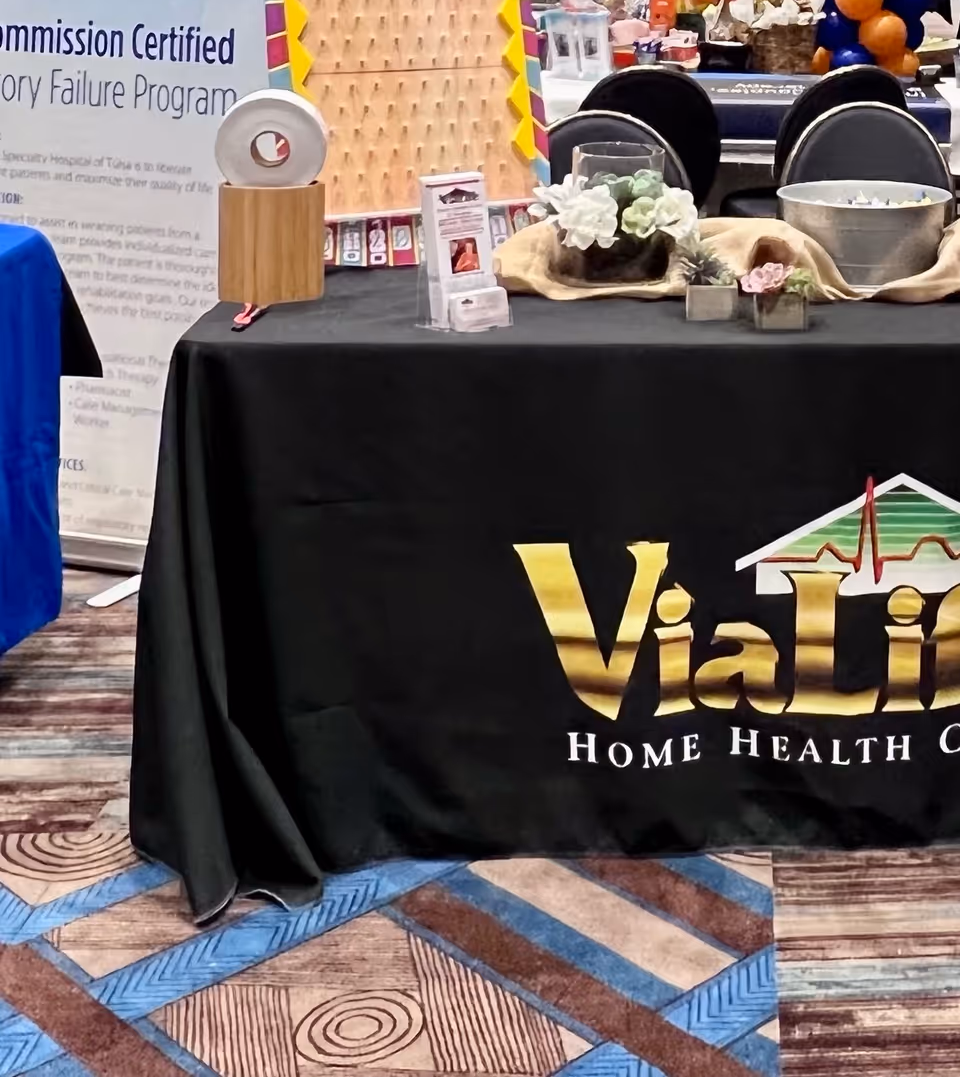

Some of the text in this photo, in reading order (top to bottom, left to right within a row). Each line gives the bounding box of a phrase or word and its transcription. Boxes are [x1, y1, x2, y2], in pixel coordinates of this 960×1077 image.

[132, 23, 235, 65] Certified
[50, 69, 125, 109] Failure
[134, 74, 237, 120] Program
[566, 730, 701, 769] HOME
[729, 725, 912, 767] HEALTH
